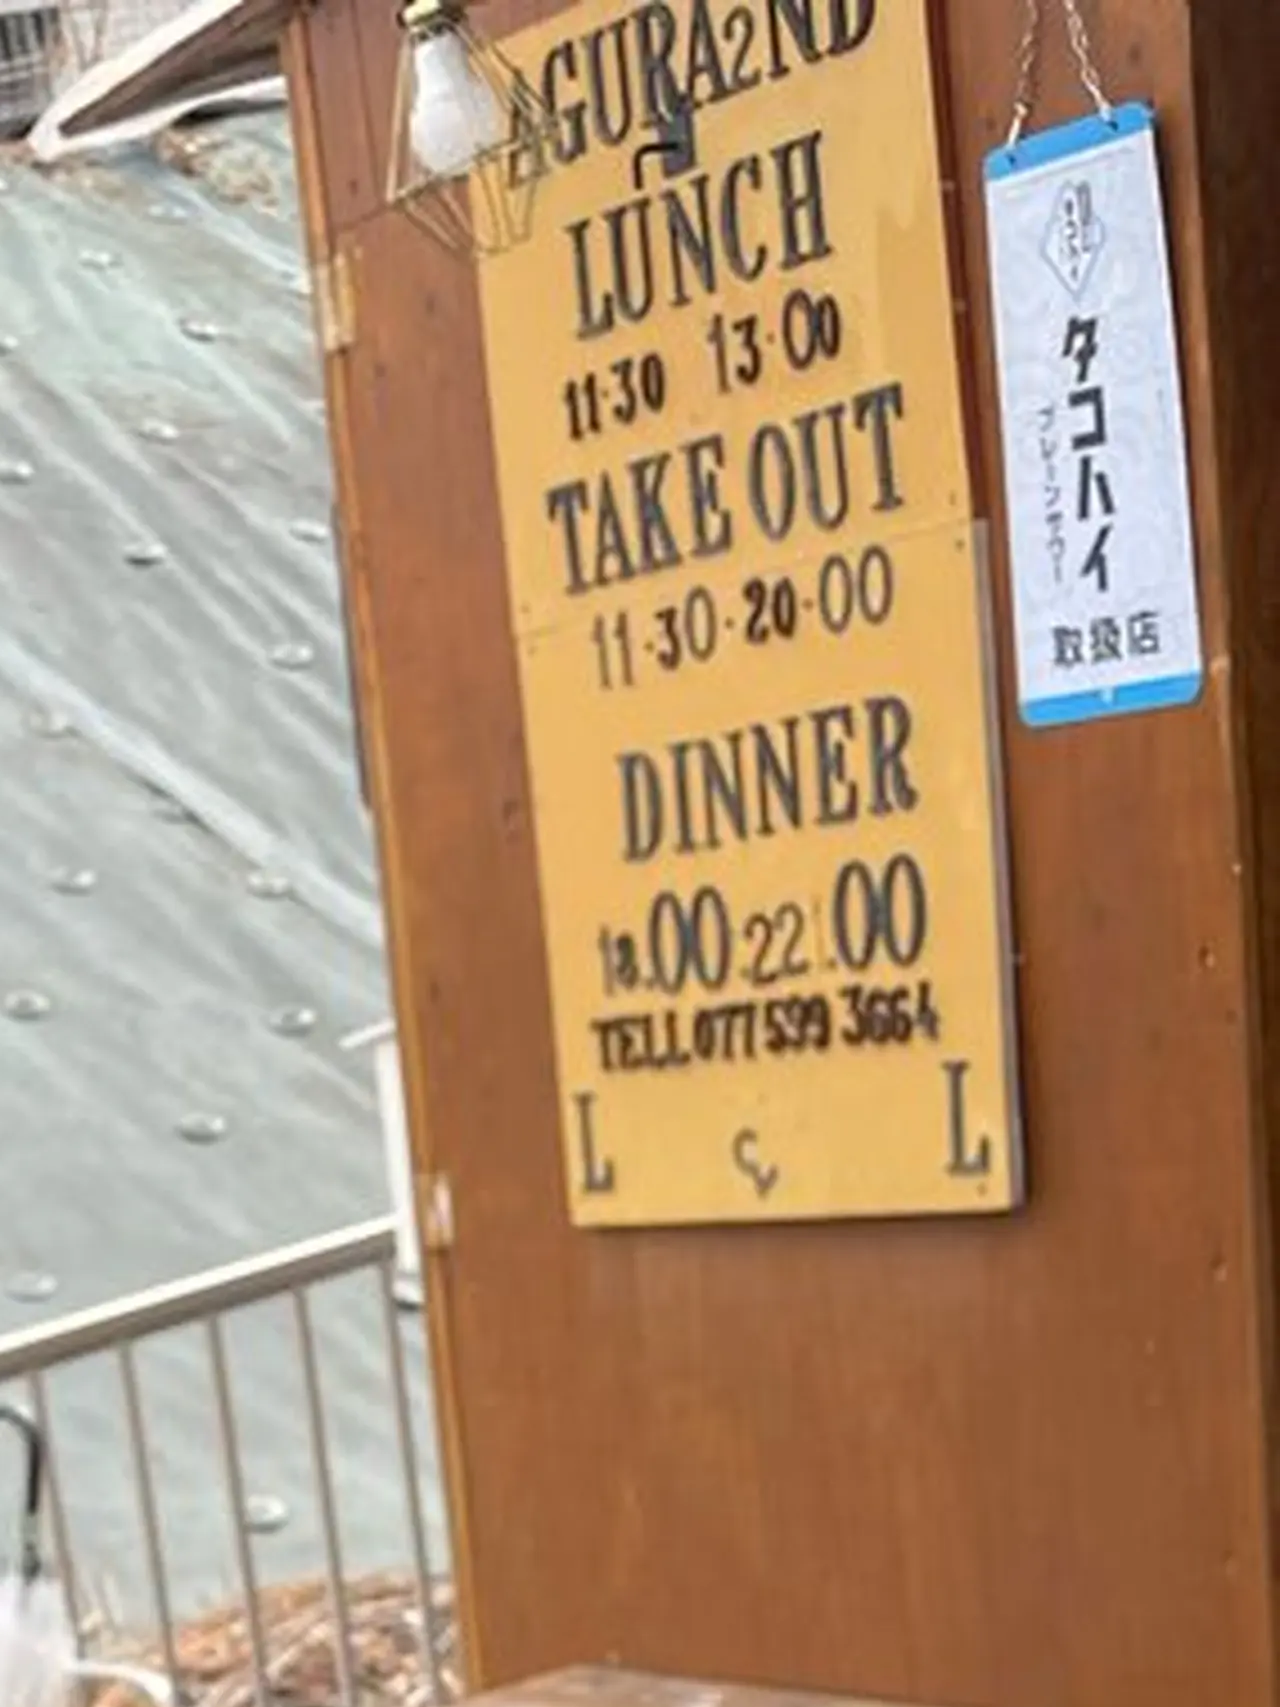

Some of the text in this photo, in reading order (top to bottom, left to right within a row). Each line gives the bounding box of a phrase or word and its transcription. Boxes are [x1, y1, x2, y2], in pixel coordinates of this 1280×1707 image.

[565, 130, 834, 340] LUNCH
[545, 382, 905, 597] TAKE OUT
[1062, 315, 1116, 592] タコハイ
[1051, 610, 1160, 668] 取扱店
[617, 696, 919, 860] DINNER
